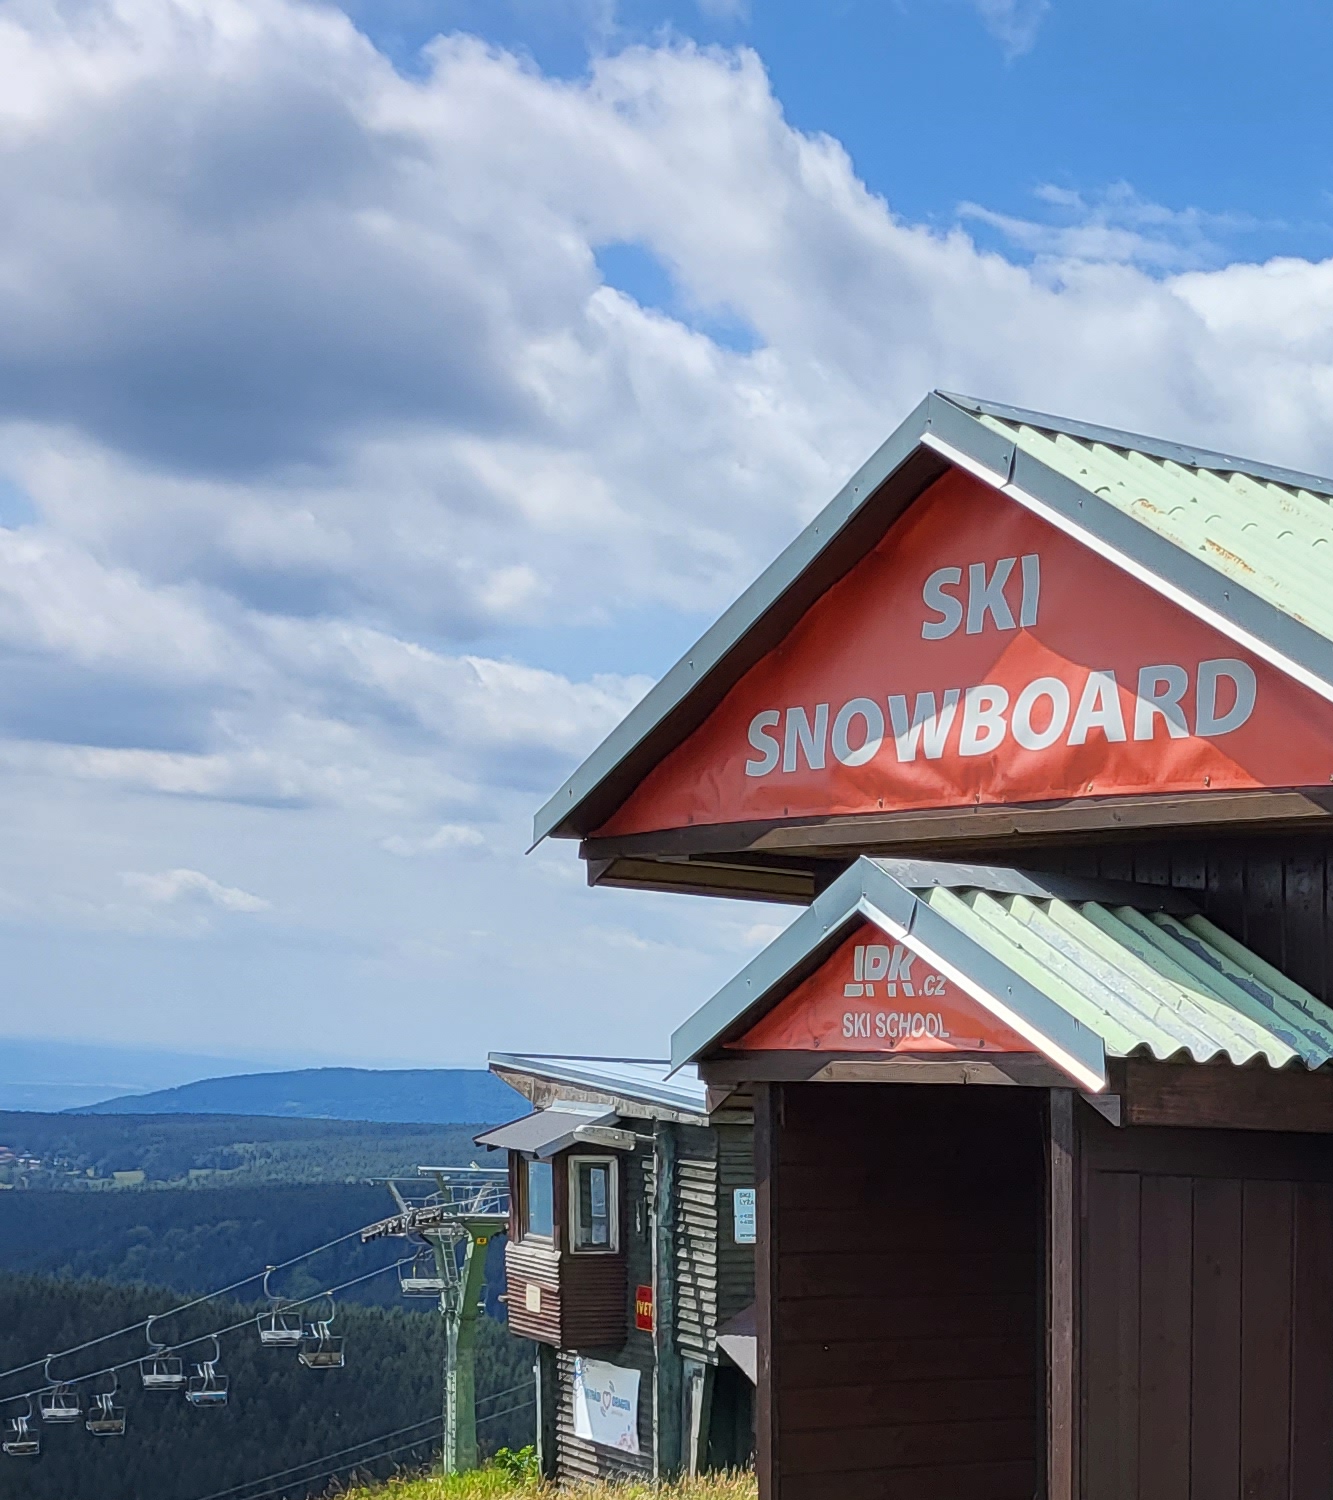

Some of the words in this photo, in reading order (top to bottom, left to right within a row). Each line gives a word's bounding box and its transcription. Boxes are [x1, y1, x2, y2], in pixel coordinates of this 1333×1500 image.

[921, 553, 1041, 641] SKI
[744, 657, 1258, 779] SNOWBOARD
[842, 1012, 872, 1038] SKI
[875, 1012, 950, 1038] SCHOOL
